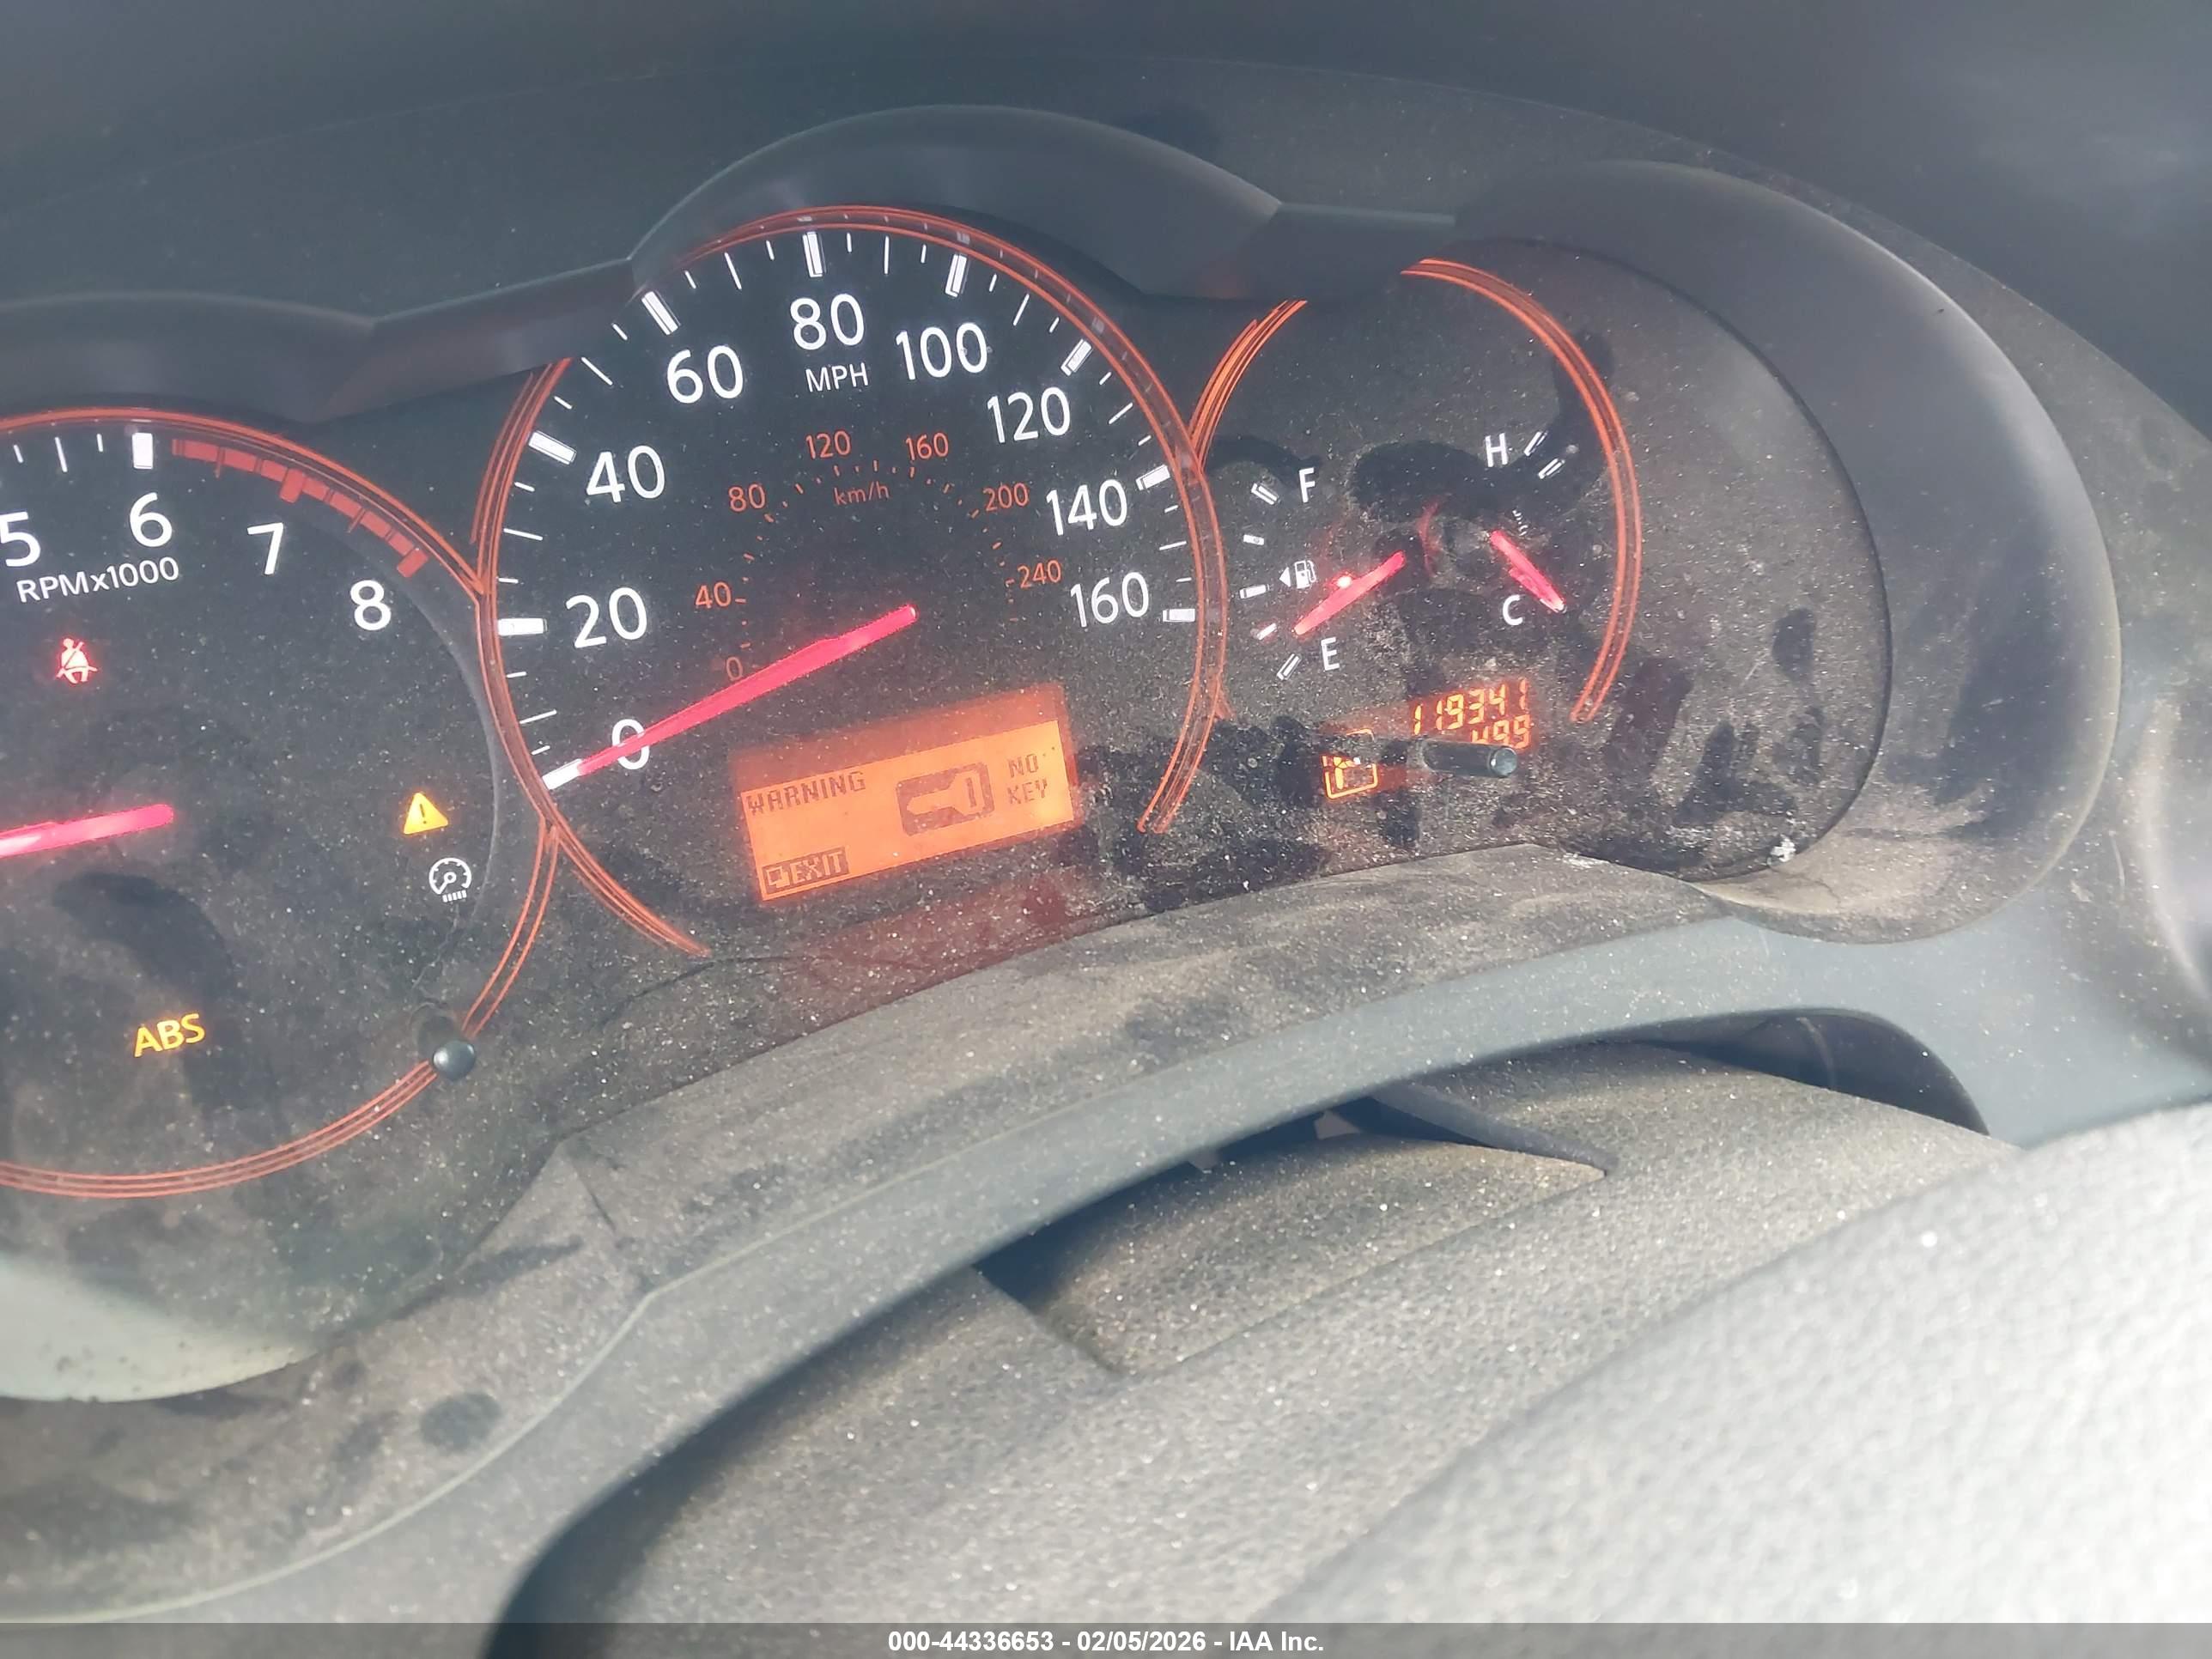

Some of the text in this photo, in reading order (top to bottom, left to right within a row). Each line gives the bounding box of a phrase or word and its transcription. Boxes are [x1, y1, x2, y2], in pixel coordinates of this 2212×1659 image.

[789, 293, 865, 350] 80
[895, 322, 988, 380] 100
[666, 345, 744, 404] 60
[805, 362, 869, 392] MPH
[986, 386, 1071, 444] 120
[805, 430, 851, 459] 120
[905, 432, 949, 461] 160
[1484, 433, 1509, 467] H
[586, 445, 665, 503] 40
[833, 481, 890, 507] km/h
[1298, 466, 1316, 502] F
[129, 492, 173, 547] 6
[728, 483, 766, 512] 80
[982, 482, 1030, 513] 200
[1045, 478, 1127, 536] 140
[0, 512, 41, 567] 5
[246, 522, 284, 574] 7
[16, 556, 179, 603] RPMx1000
[695, 581, 732, 609] 40
[1018, 559, 1062, 589] 240
[349, 580, 392, 630] 8
[566, 587, 647, 648] 20
[1070, 572, 1150, 628] 160
[1502, 593, 1523, 626] C
[726, 657, 744, 682] 0
[1320, 636, 1340, 671] E
[1413, 678, 1528, 736] 119341
[611, 719, 650, 770] 0
[1007, 752, 1039, 779] NO
[748, 771, 866, 816] WARNING
[1006, 779, 1048, 805] KEY
[791, 851, 846, 884] EXIT
[133, 1013, 205, 1057] ABS
